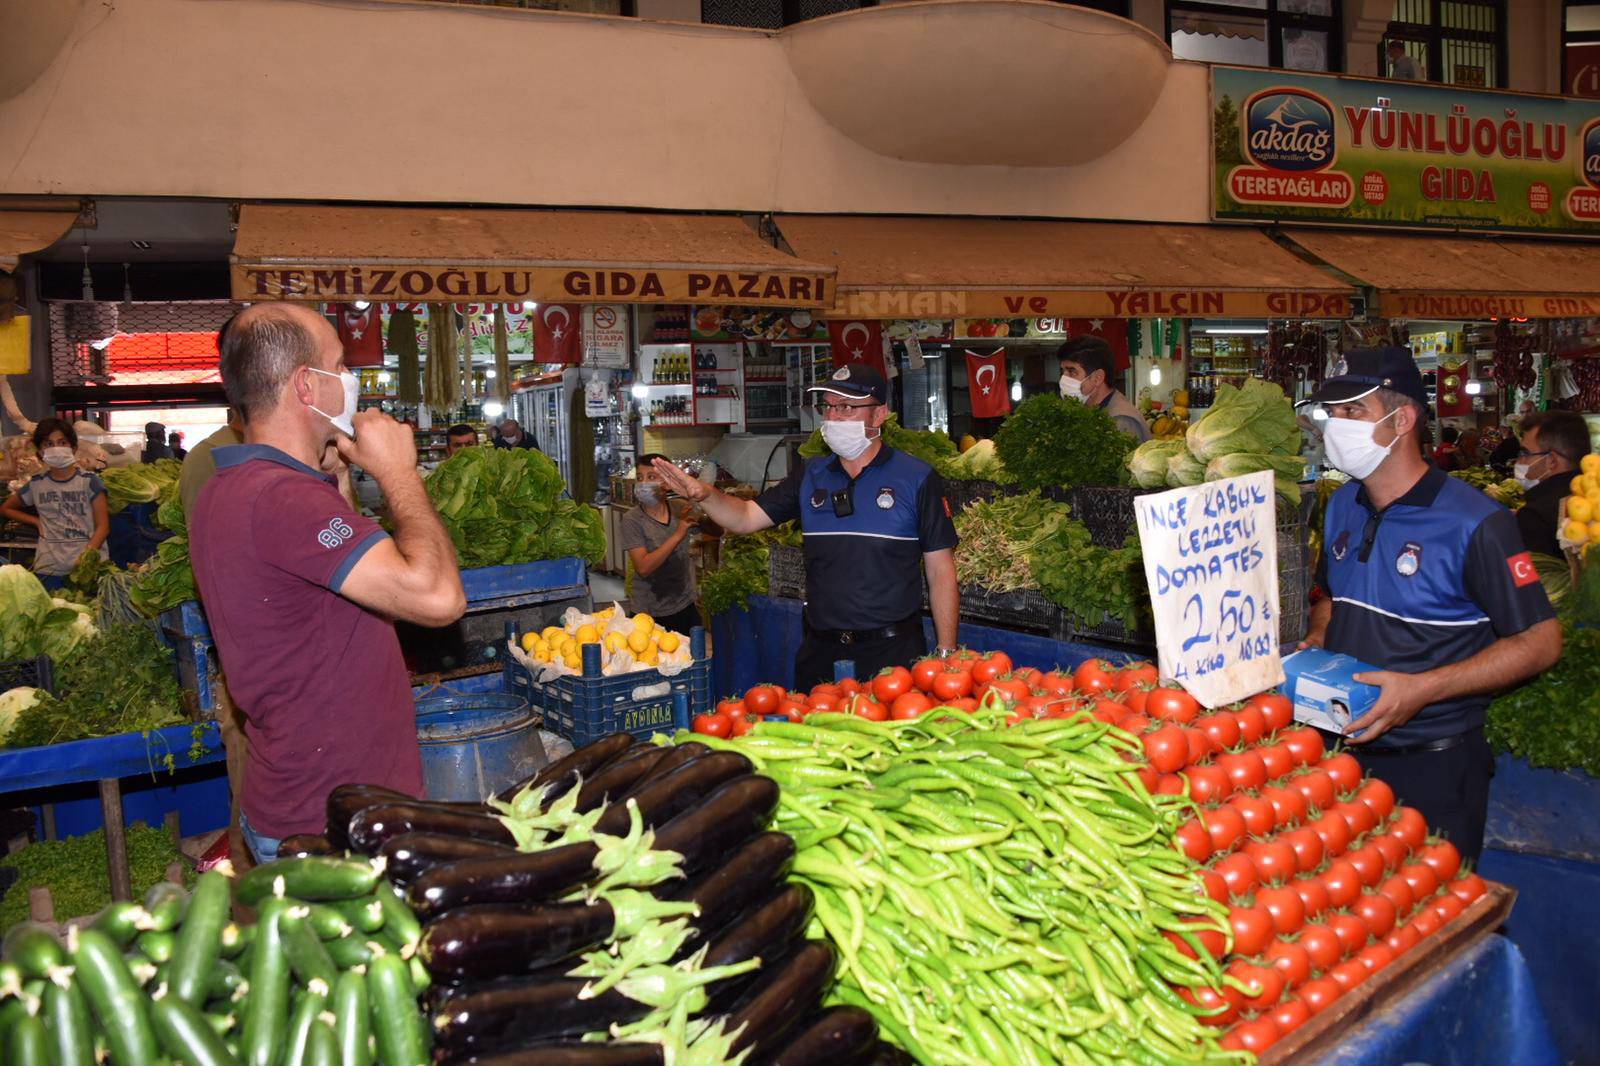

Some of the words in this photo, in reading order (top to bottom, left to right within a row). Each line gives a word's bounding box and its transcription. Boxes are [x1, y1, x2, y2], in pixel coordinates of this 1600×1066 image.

[1251, 123, 1330, 161] akdağ
[1344, 97, 1567, 163] YÜNLÜOĞLU
[1235, 175, 1348, 199] TEREYAĞLARI
[1364, 183, 1384, 192] LEZZET
[1421, 165, 1497, 203] GIDA
[1572, 196, 1600, 212] TER
[564, 271, 665, 297] GIDA
[688, 273, 825, 301] PAZARI
[1004, 296, 1048, 315] ve
[1106, 291, 1225, 316] YALÇIN
[1266, 292, 1344, 315] GIDA
[1544, 298, 1595, 316] GIDA
[1203, 483, 1266, 518] KABUK
[318, 517, 353, 549] 86
[1182, 590, 1255, 652] 2,50
[1175, 662, 1189, 680] 4
